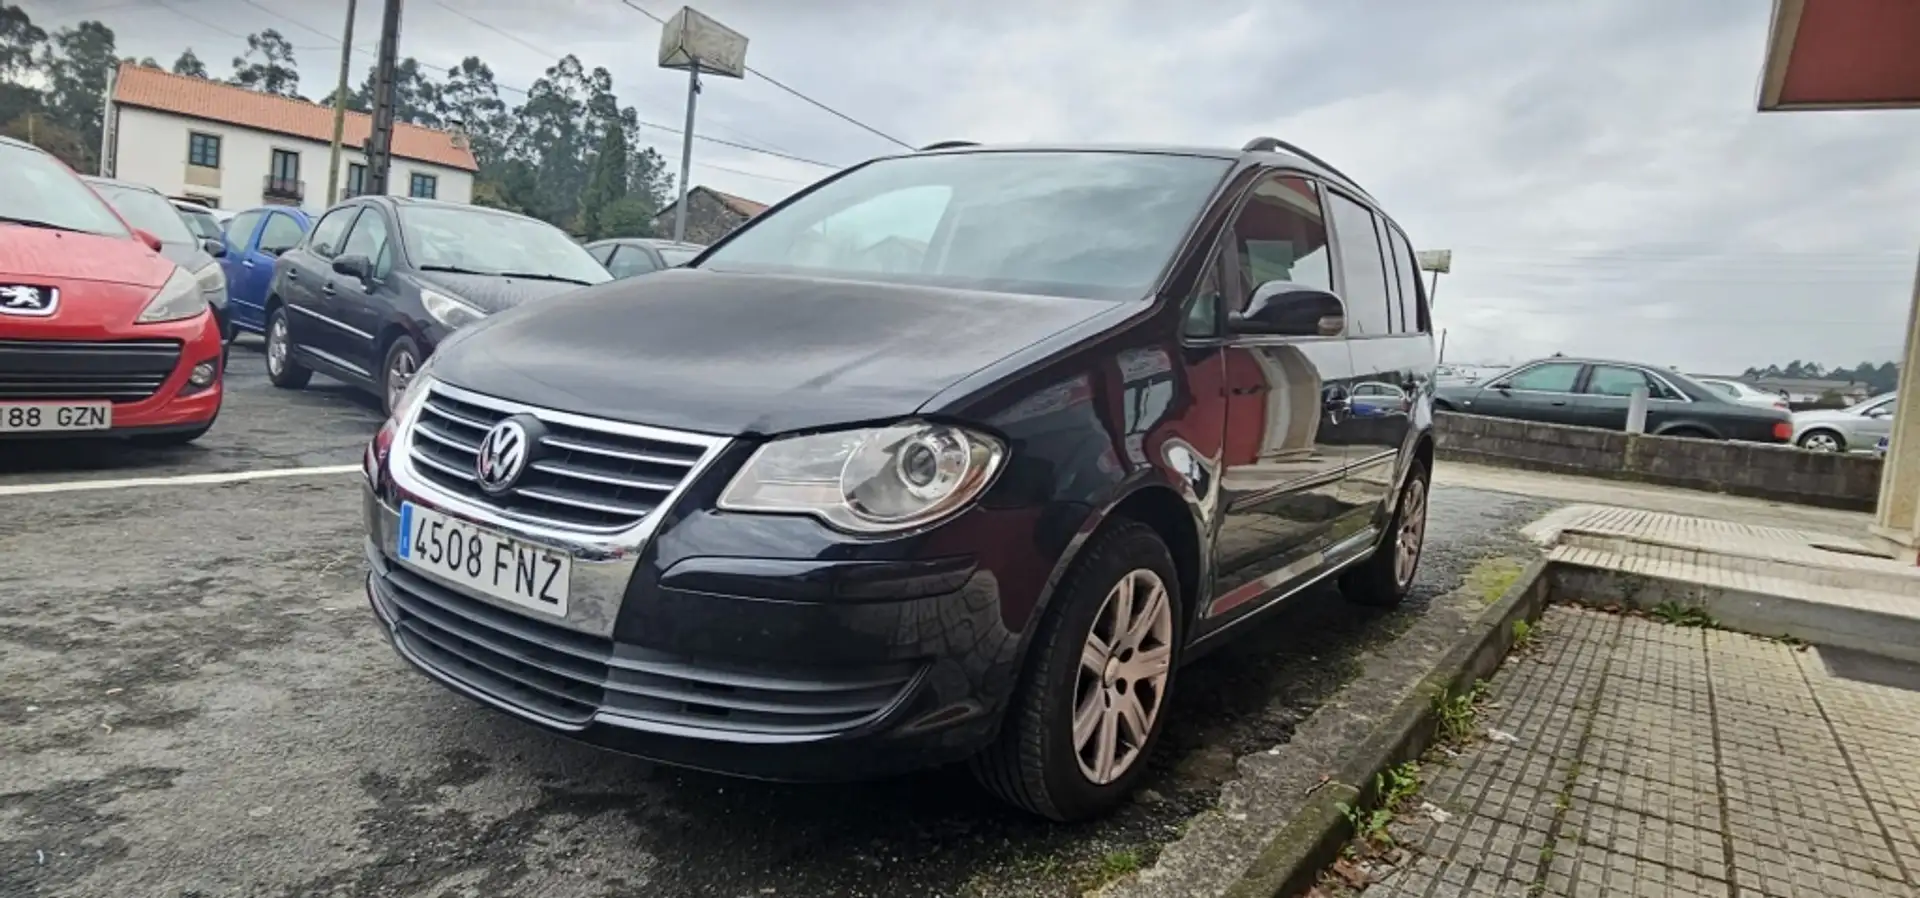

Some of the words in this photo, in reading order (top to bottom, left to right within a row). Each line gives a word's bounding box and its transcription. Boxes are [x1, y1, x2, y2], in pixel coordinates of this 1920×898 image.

[57, 406, 105, 426] GZN
[480, 421, 525, 489] VW
[415, 517, 483, 578] 4508
[493, 541, 562, 605] FNZ
